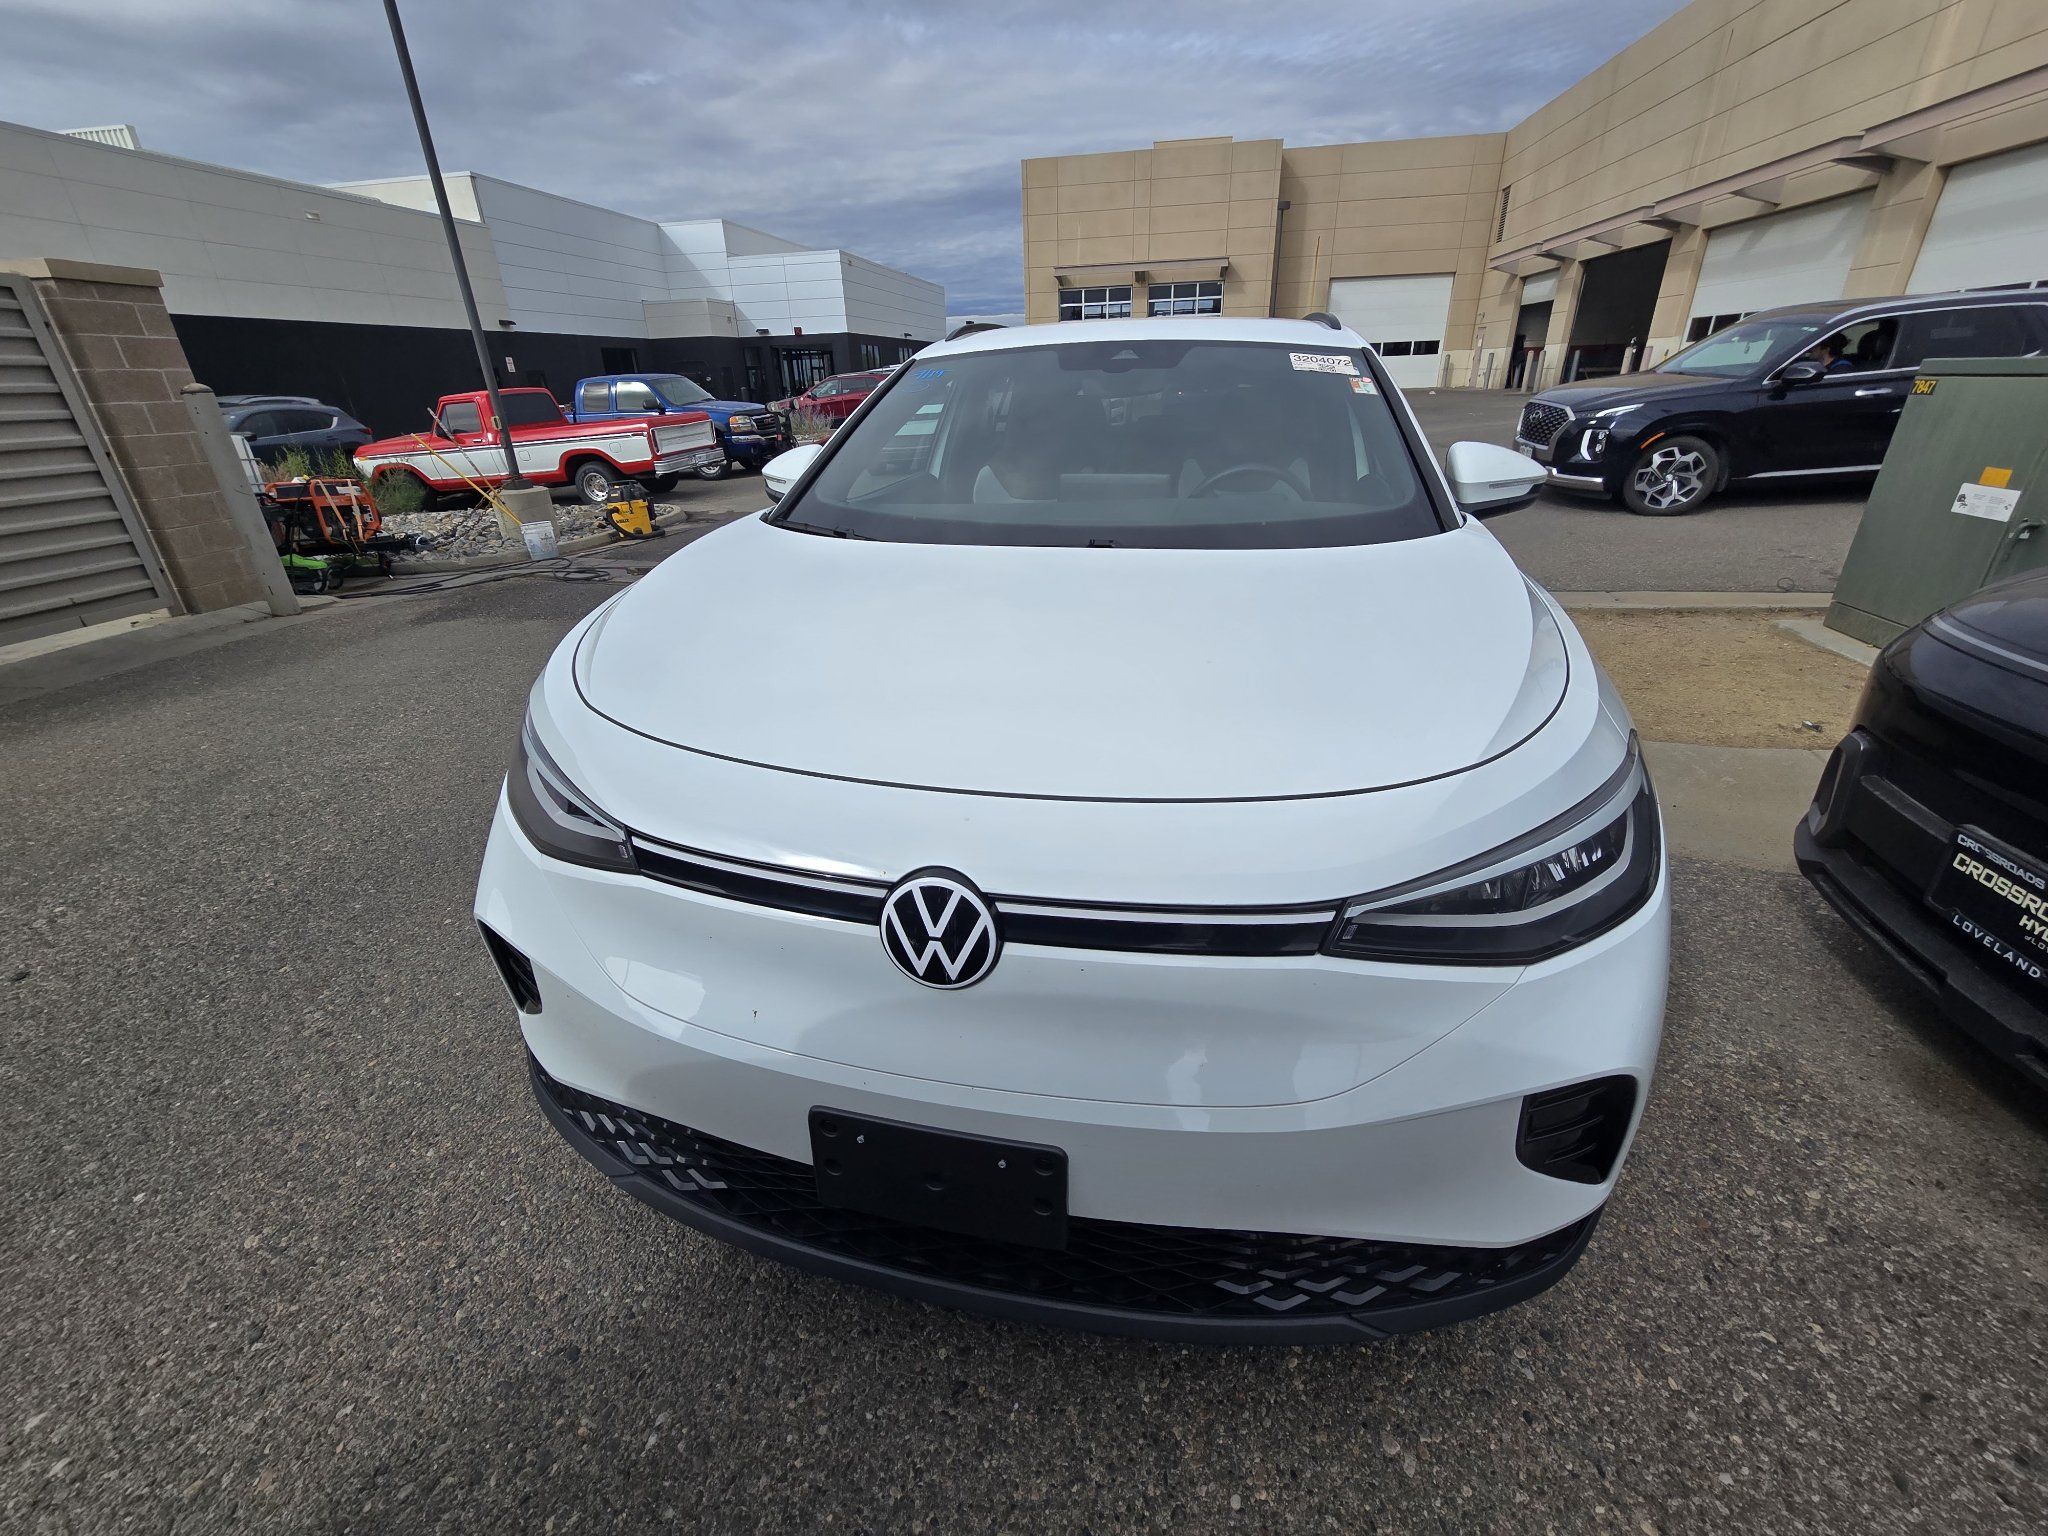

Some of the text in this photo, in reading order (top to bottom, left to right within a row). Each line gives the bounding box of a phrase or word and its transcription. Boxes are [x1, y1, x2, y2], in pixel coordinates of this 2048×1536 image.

[1293, 355, 1352, 366] 3204072
[1911, 380, 1936, 394] 7847
[1957, 833, 2046, 890] CROSSROADS
[881, 877, 997, 989] VW
[1952, 914, 2041, 978] LOVELAND
